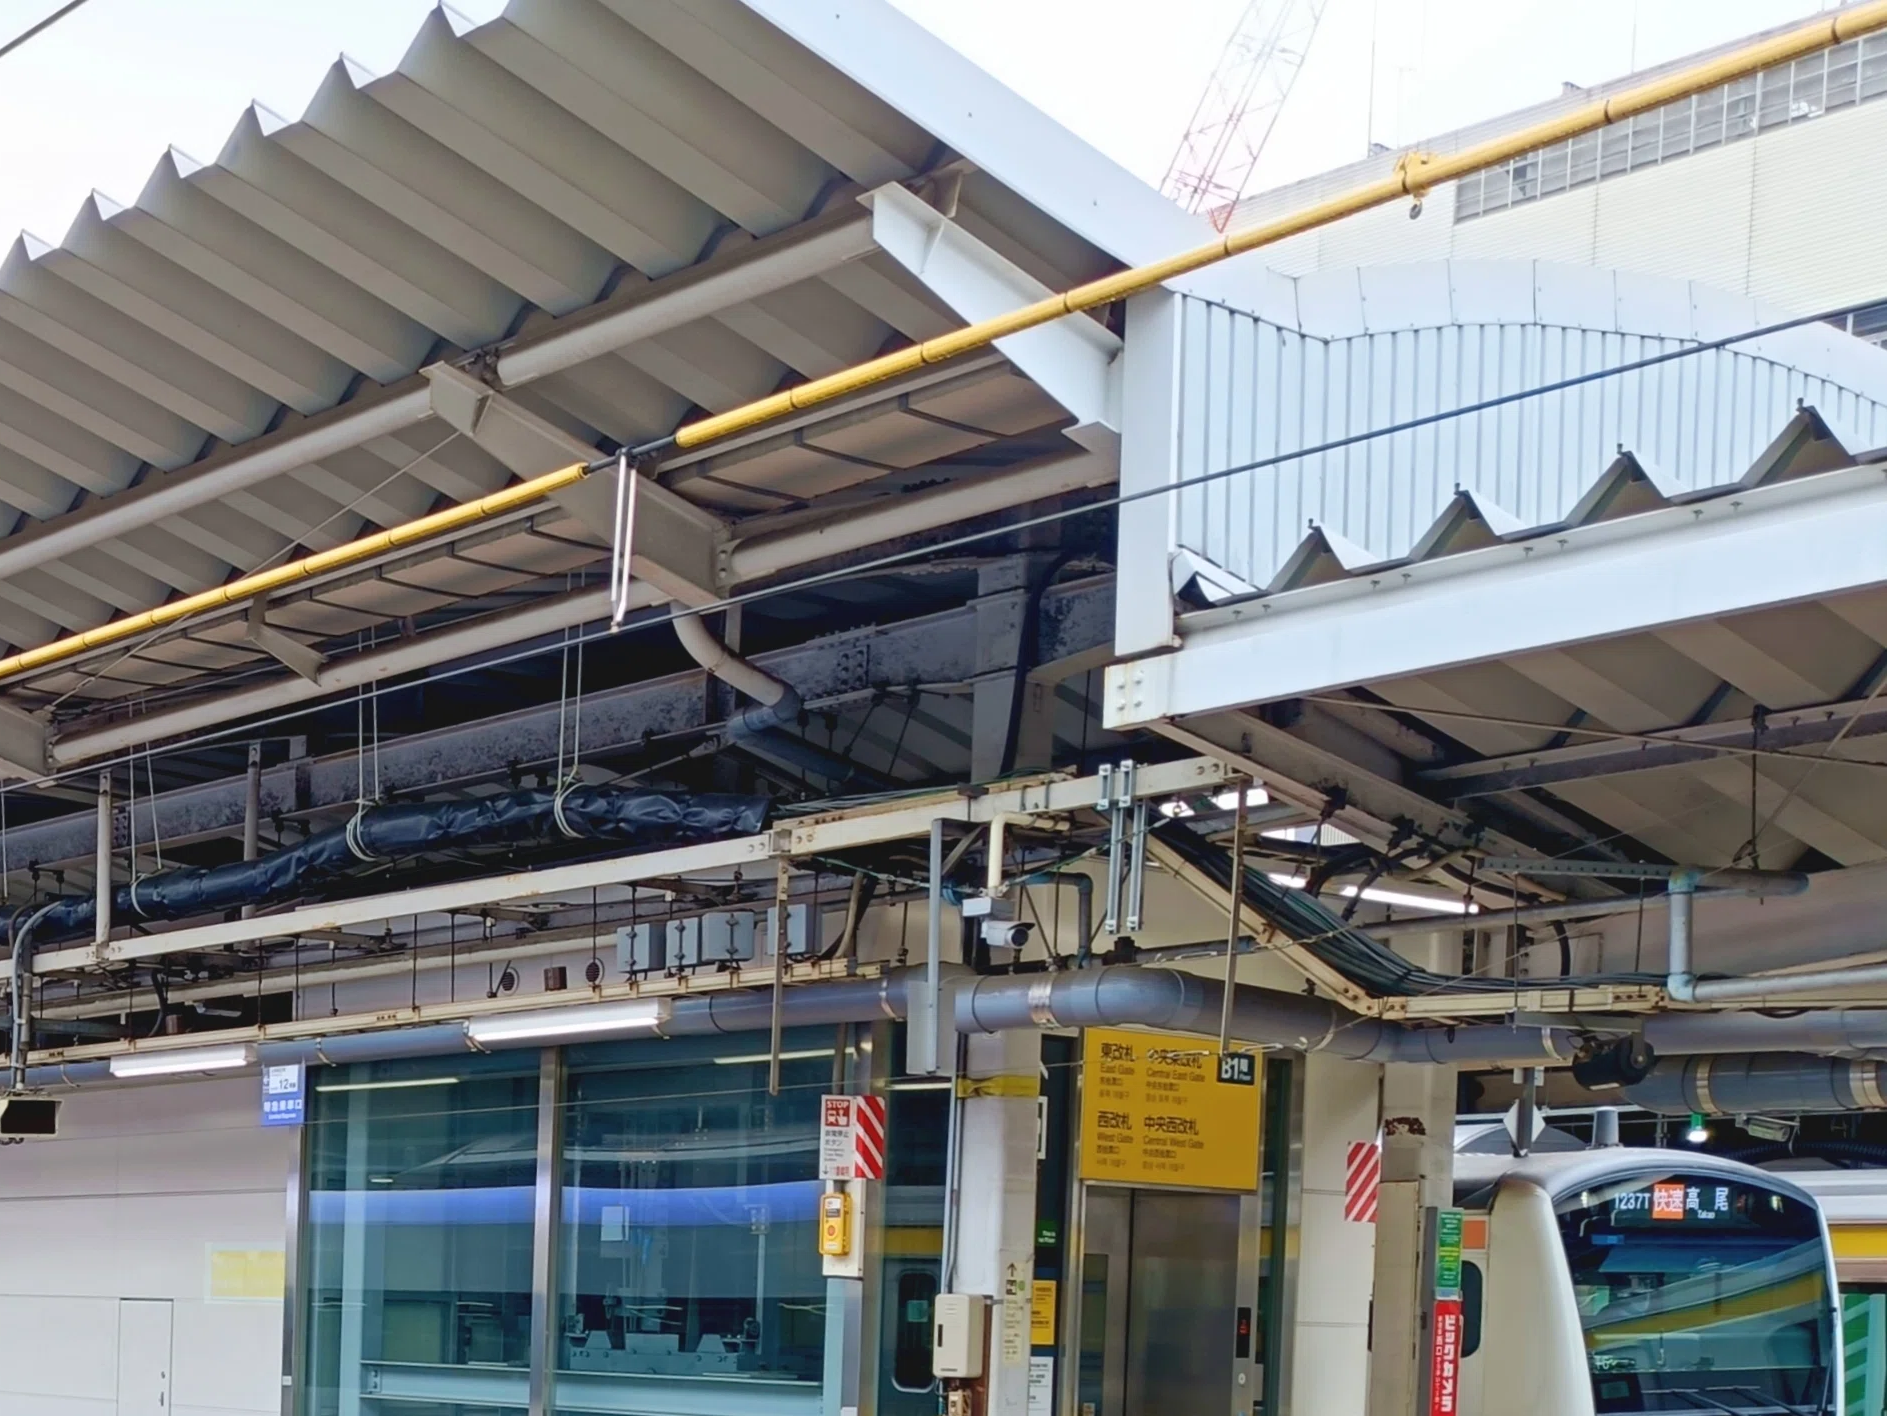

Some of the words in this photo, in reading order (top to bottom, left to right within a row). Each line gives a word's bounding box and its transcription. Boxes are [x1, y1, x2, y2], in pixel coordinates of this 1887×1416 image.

[1098, 1111, 1132, 1131] 西改札
[1144, 1114, 1199, 1136] 中央西改札
[1614, 1193, 1651, 1210] 1237T
[1653, 1187, 1684, 1212] 快速
